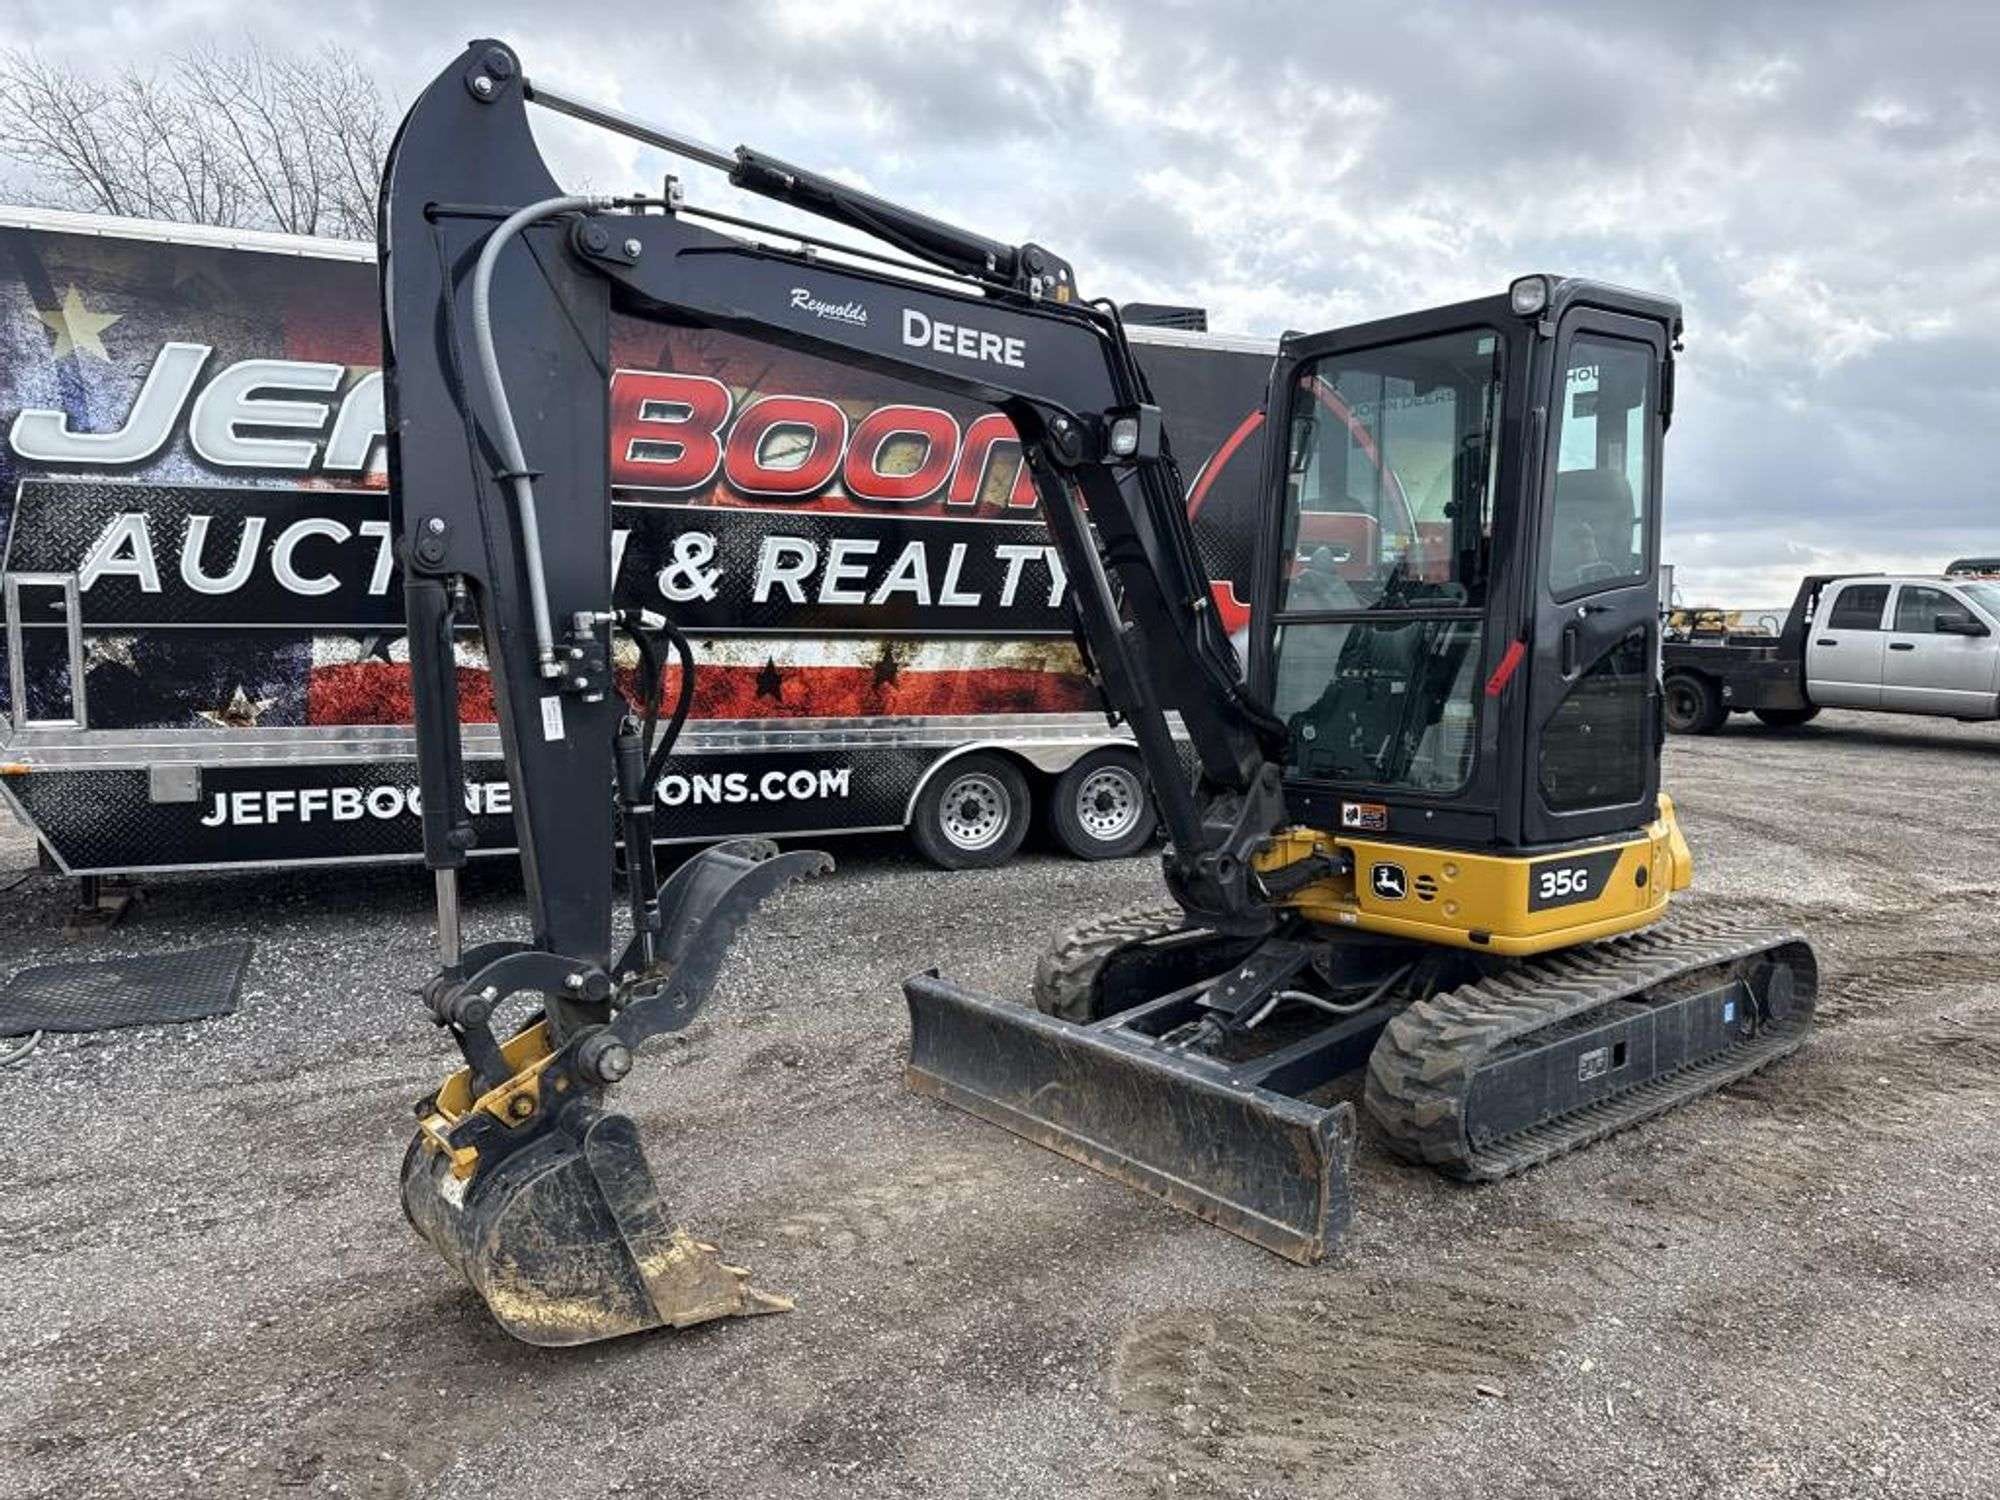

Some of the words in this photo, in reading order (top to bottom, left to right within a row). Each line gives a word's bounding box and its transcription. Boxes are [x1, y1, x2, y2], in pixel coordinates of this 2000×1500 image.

[790, 287, 868, 320] Reynolds
[902, 308, 1026, 368] DEERE
[657, 530, 720, 602] &
[1539, 868, 1588, 898] 35G
